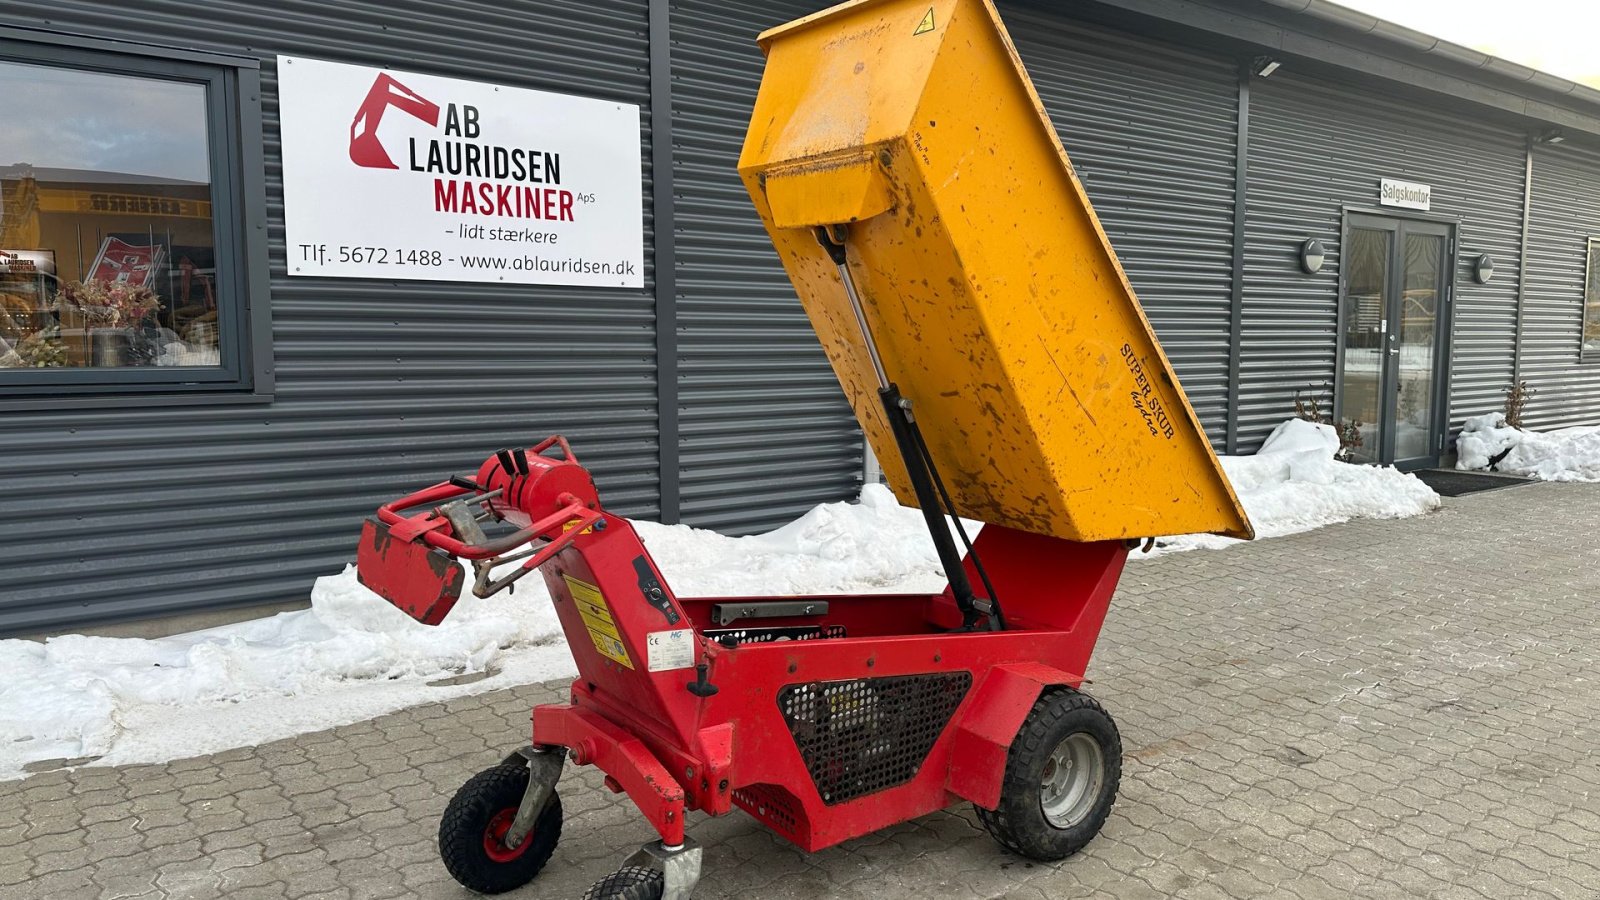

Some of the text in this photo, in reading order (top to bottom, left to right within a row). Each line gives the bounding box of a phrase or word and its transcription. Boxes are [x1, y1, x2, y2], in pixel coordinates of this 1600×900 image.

[444, 102, 481, 139] AB
[409, 137, 561, 185] LAURIDSEN
[434, 178, 596, 222] MASKINER ApS
[1382, 183, 1429, 204] Salgskontor
[459, 223, 485, 240] lidt
[489, 226, 558, 244] stærkere
[299, 244, 332, 266] Tlf.
[339, 246, 389, 265] 5672
[395, 248, 442, 267] 1488
[460, 254, 635, 276] www.ablauridsen.dk
[1120, 343, 1175, 440] SUPER SKUB
[1130, 391, 1158, 437] hydra
